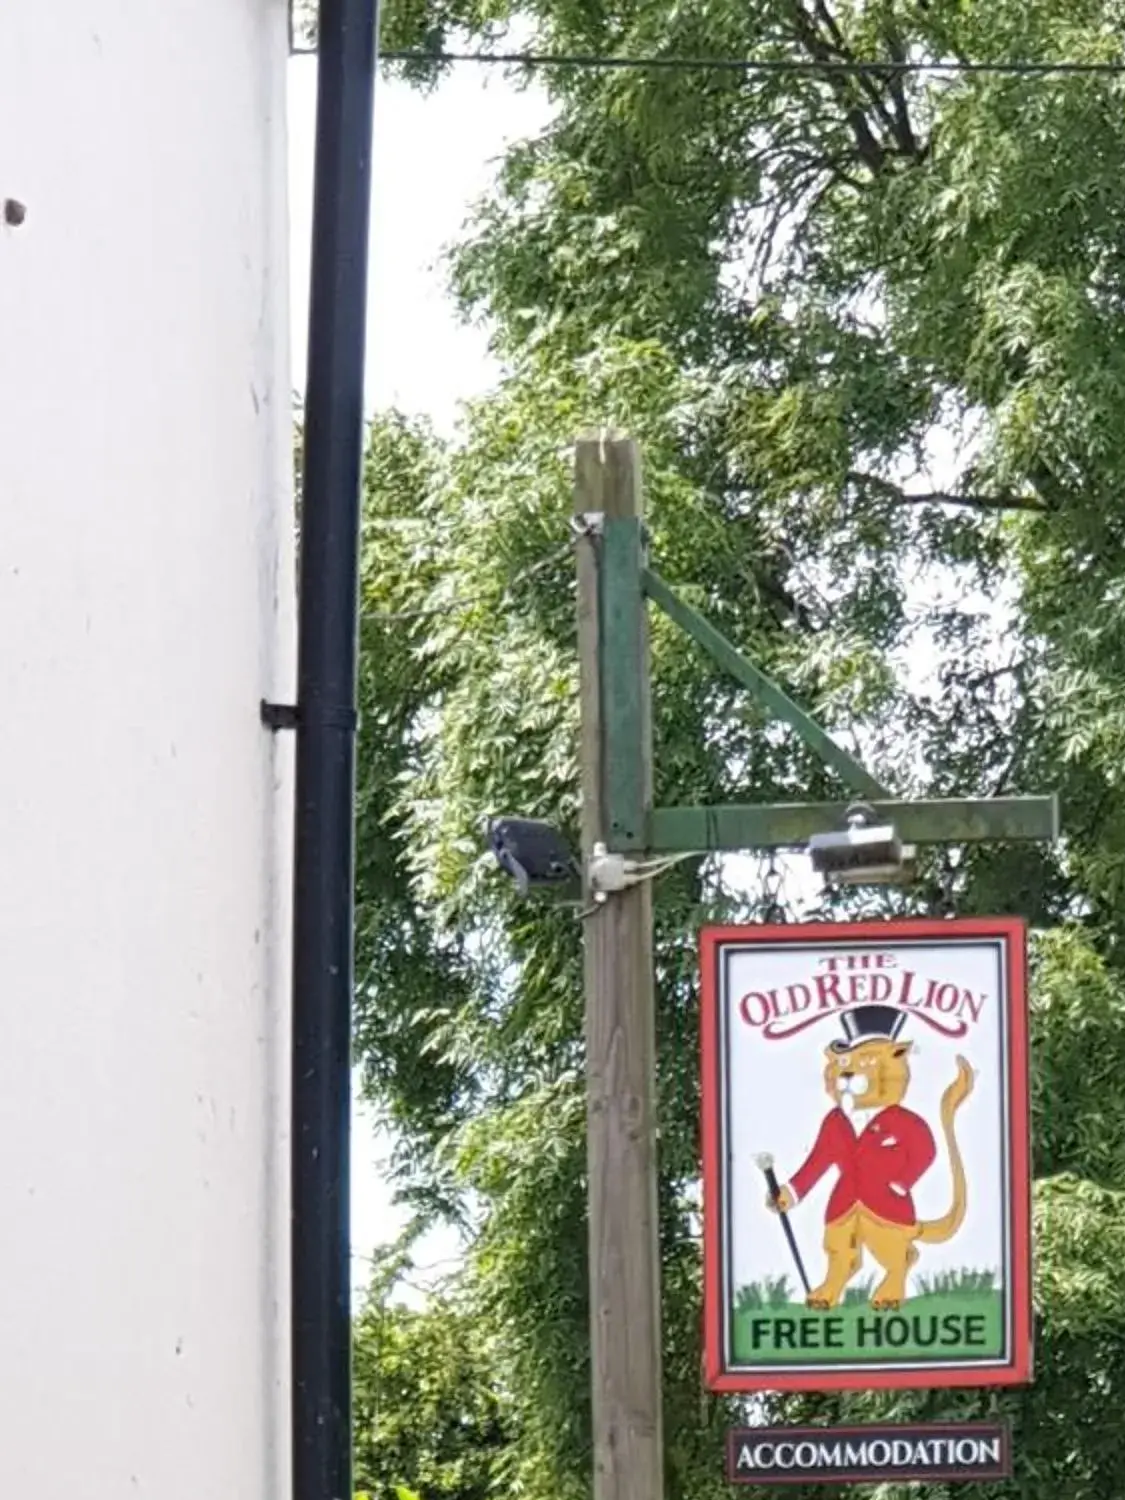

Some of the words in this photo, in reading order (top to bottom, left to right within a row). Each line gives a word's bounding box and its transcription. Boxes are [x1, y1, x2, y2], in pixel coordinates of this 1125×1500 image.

[818, 954, 897, 971] THE
[739, 983, 811, 1027] OLD
[812, 973, 892, 1010] RED
[900, 971, 988, 1023] LION
[751, 1316, 844, 1349] FREE
[856, 1315, 986, 1347] HOUSE
[736, 1438, 1000, 1469] ACCOMMODATION
